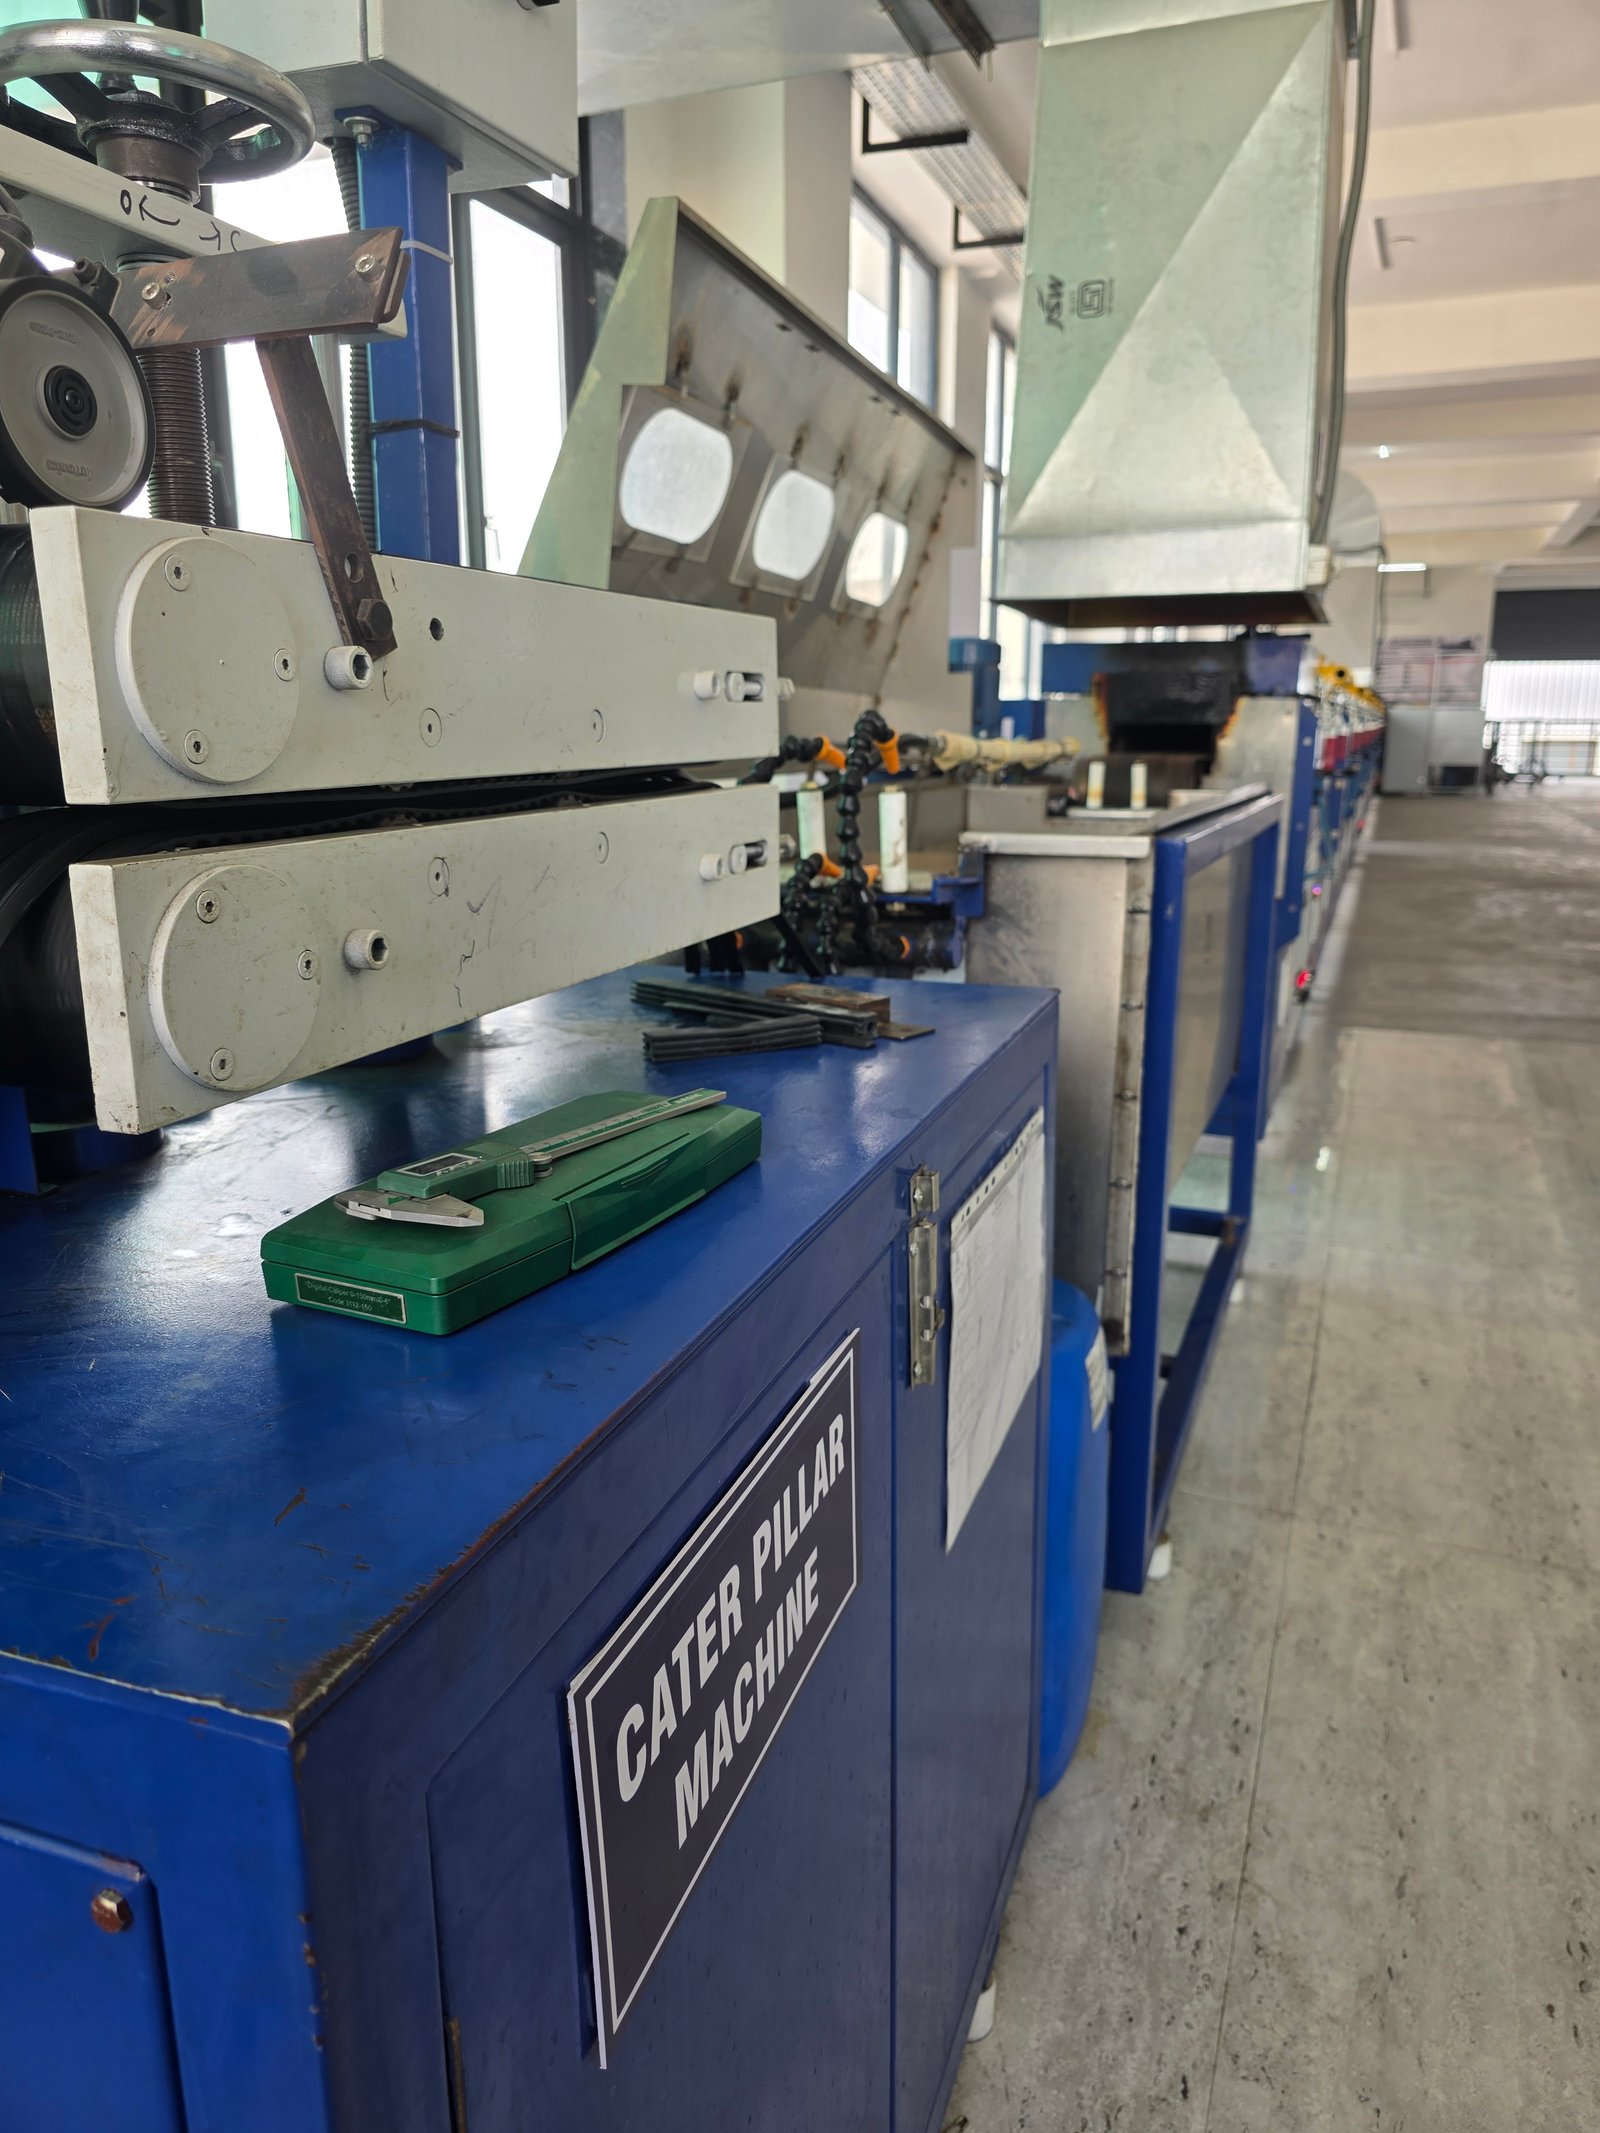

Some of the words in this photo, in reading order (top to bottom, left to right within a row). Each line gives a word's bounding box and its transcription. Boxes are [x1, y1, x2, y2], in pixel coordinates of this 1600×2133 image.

[120, 189, 181, 226] OK
[328, 1295, 344, 1305] Code
[615, 1583, 742, 1803] CATER
[753, 1412, 846, 1602] PILLAR
[675, 1545, 820, 1851] MACHINE
